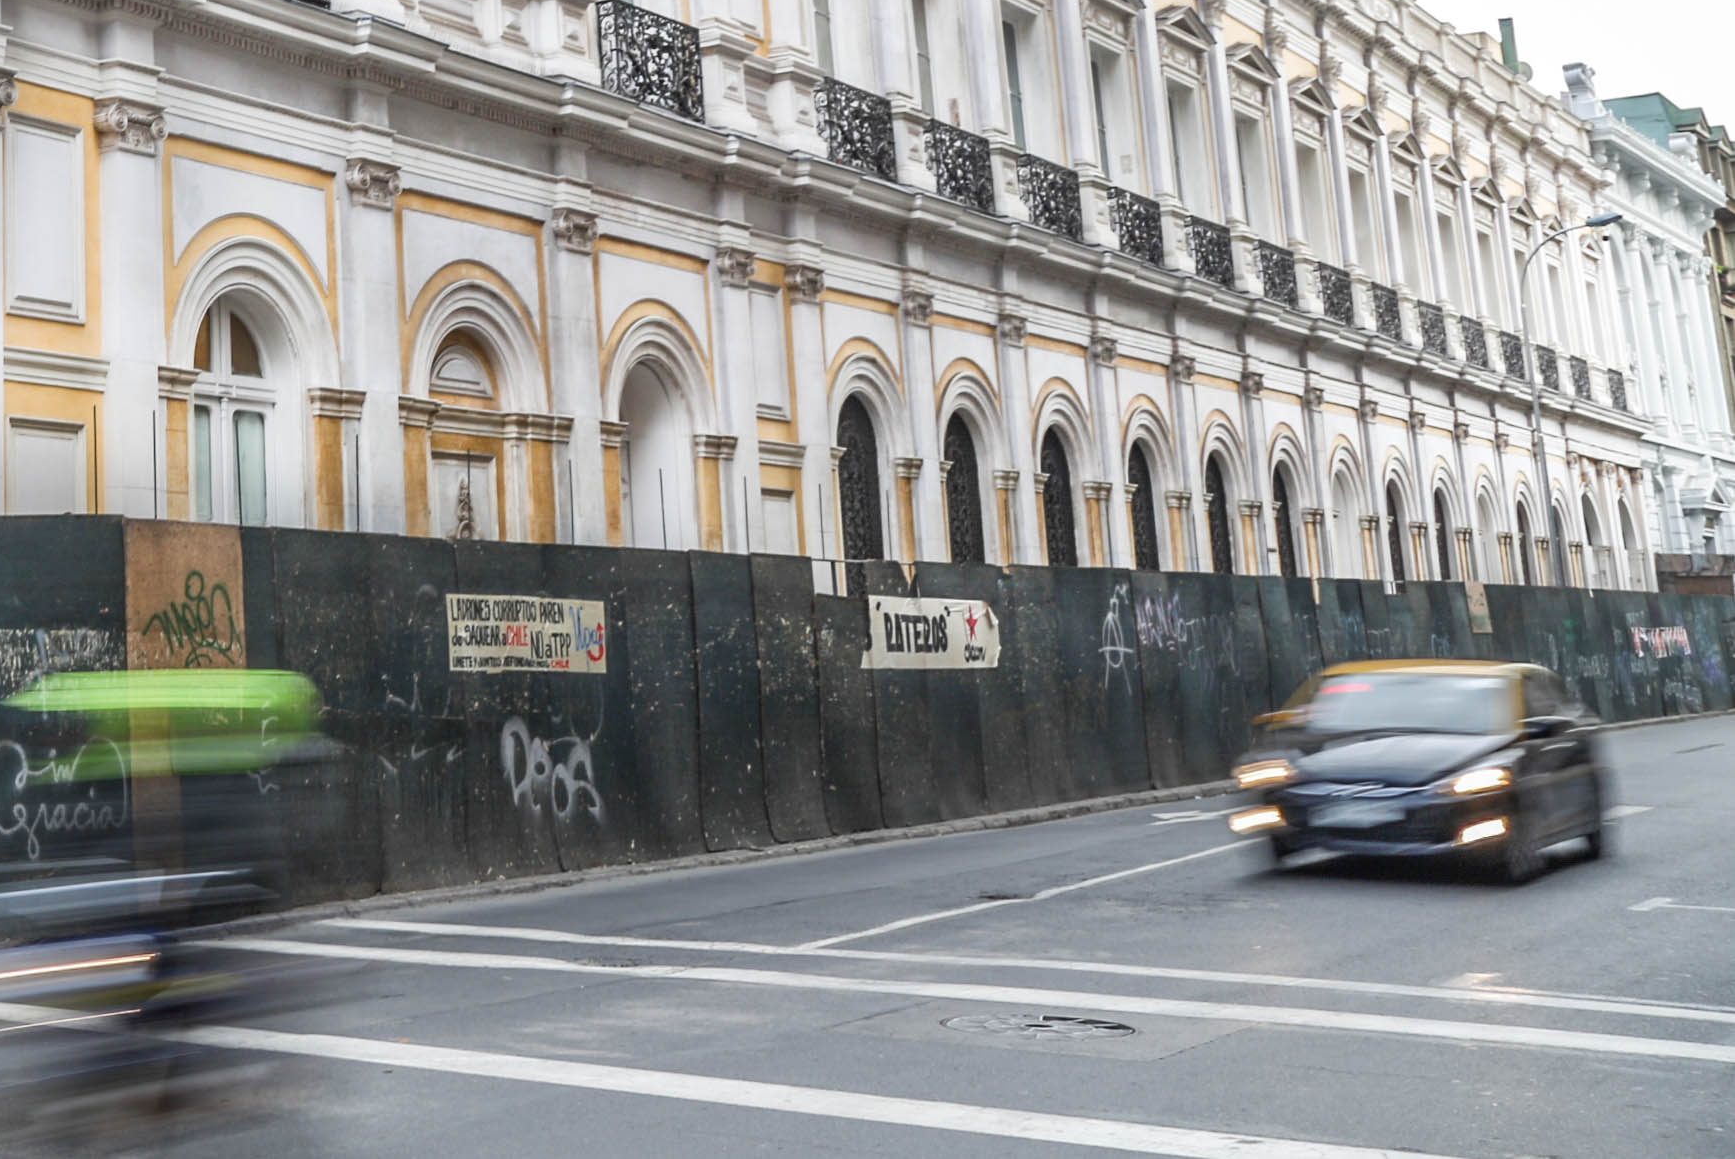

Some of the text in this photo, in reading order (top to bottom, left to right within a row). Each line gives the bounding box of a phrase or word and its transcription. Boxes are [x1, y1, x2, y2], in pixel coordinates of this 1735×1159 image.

[450, 598, 490, 621] LADRONES
[539, 601, 565, 623] PAREN
[452, 625, 463, 646] de
[464, 624, 501, 647] SAQUEAR
[507, 625, 529, 646] CHILE
[530, 631, 544, 659] NO
[545, 643, 553, 658] a
[552, 632, 571, 658] TPP
